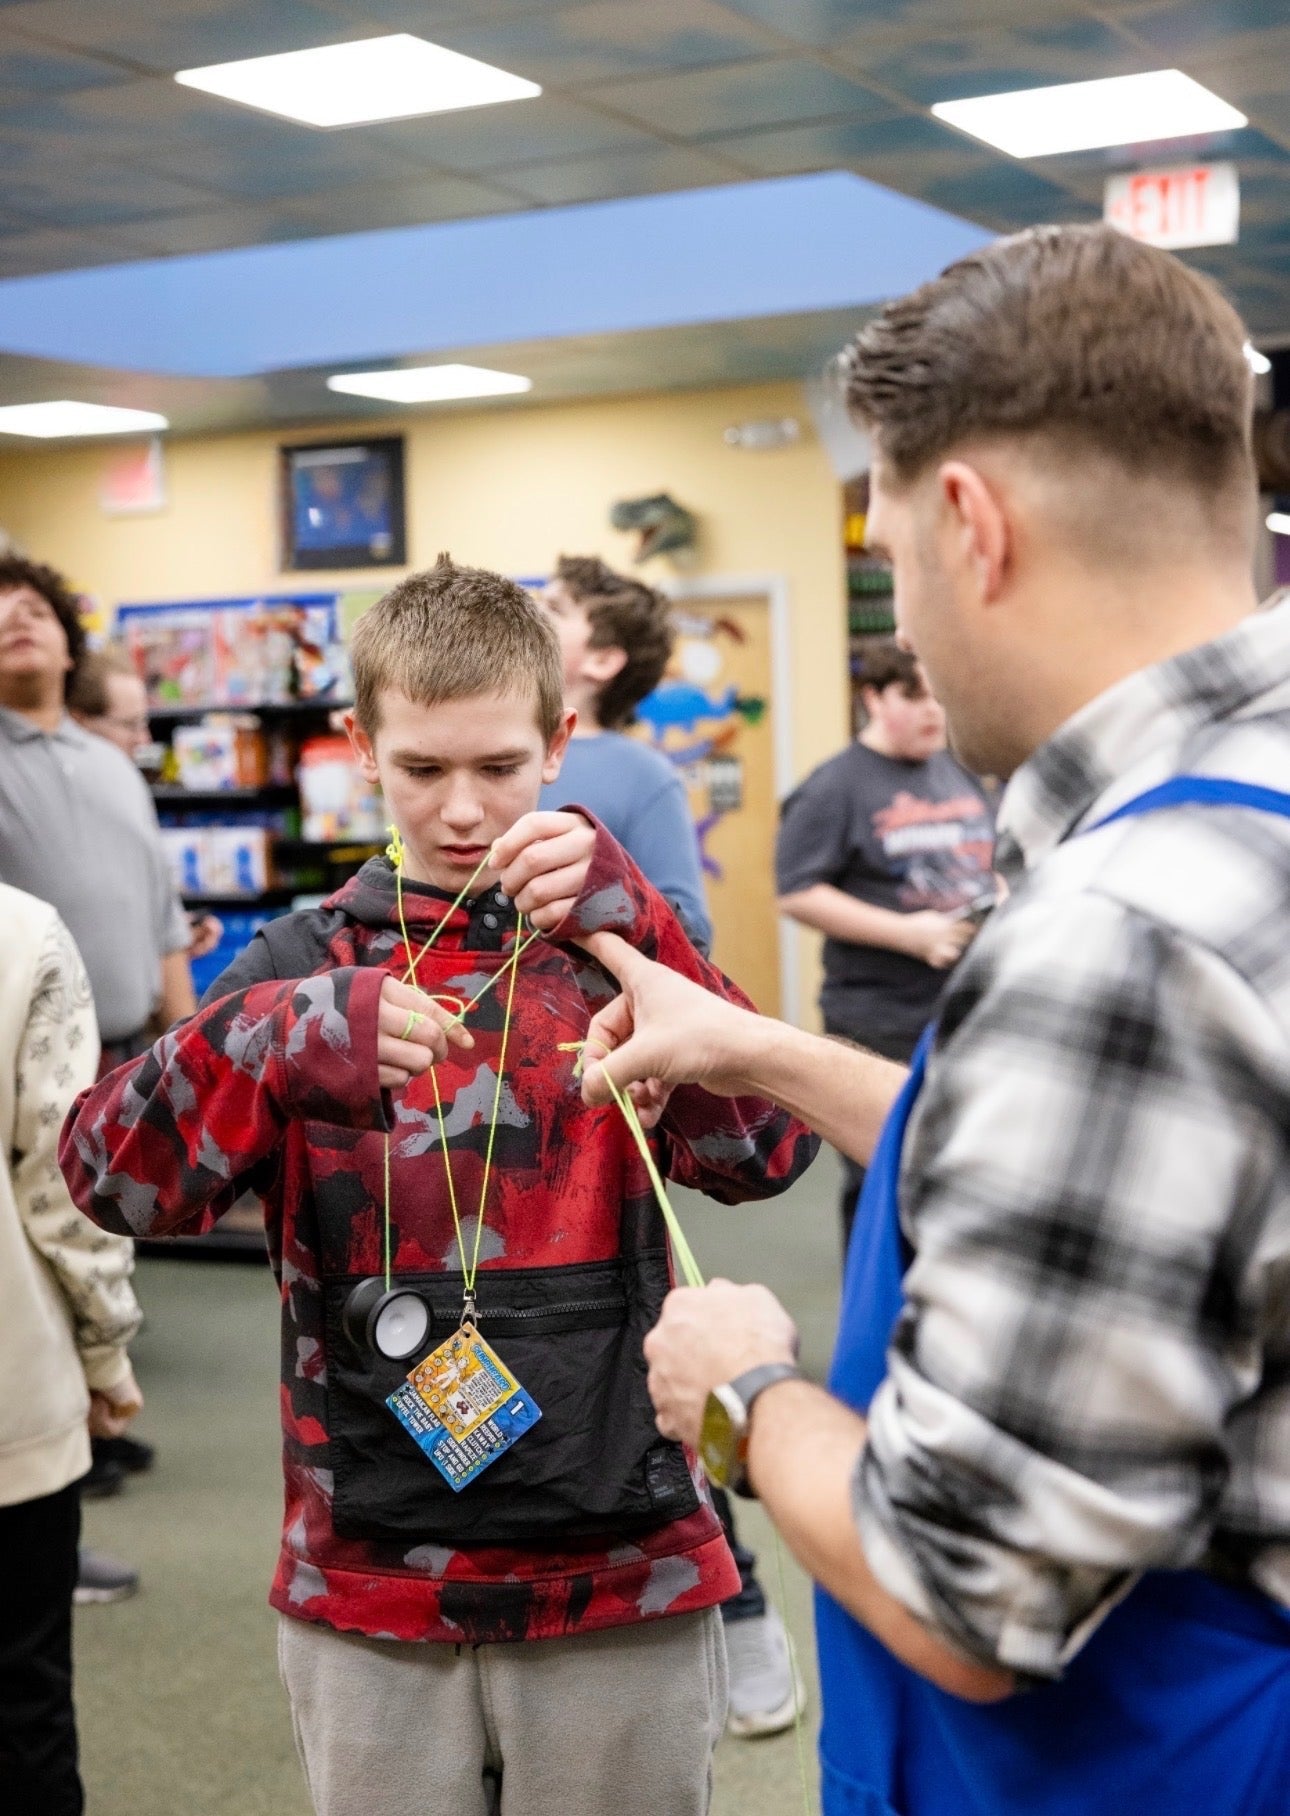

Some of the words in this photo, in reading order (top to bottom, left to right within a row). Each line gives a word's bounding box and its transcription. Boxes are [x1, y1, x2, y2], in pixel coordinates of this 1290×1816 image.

[395, 1400, 410, 1416] EIFFEL
[407, 1414, 423, 1434] TOWER
[402, 1394, 415, 1409] ROCK
[412, 1407, 423, 1419] THE
[419, 1417, 433, 1432] BABY
[408, 1388, 431, 1415] JAMAICAN
[427, 1412, 441, 1427] FLAG
[510, 1401, 524, 1415] 1
[479, 1423, 497, 1443] REEPER
[486, 1418, 503, 1438] WORLD
[466, 1434, 484, 1455] CLUTCH
[472, 1429, 490, 1449] KAWAY
[433, 1448, 444, 1461] UFO
[437, 1439, 450, 1454] STOP
[447, 1453, 459, 1465] AND
[455, 1463, 464, 1472] GO
[446, 1436, 471, 1466] SIDEWINDER
[459, 1440, 478, 1461] RAPEZE
